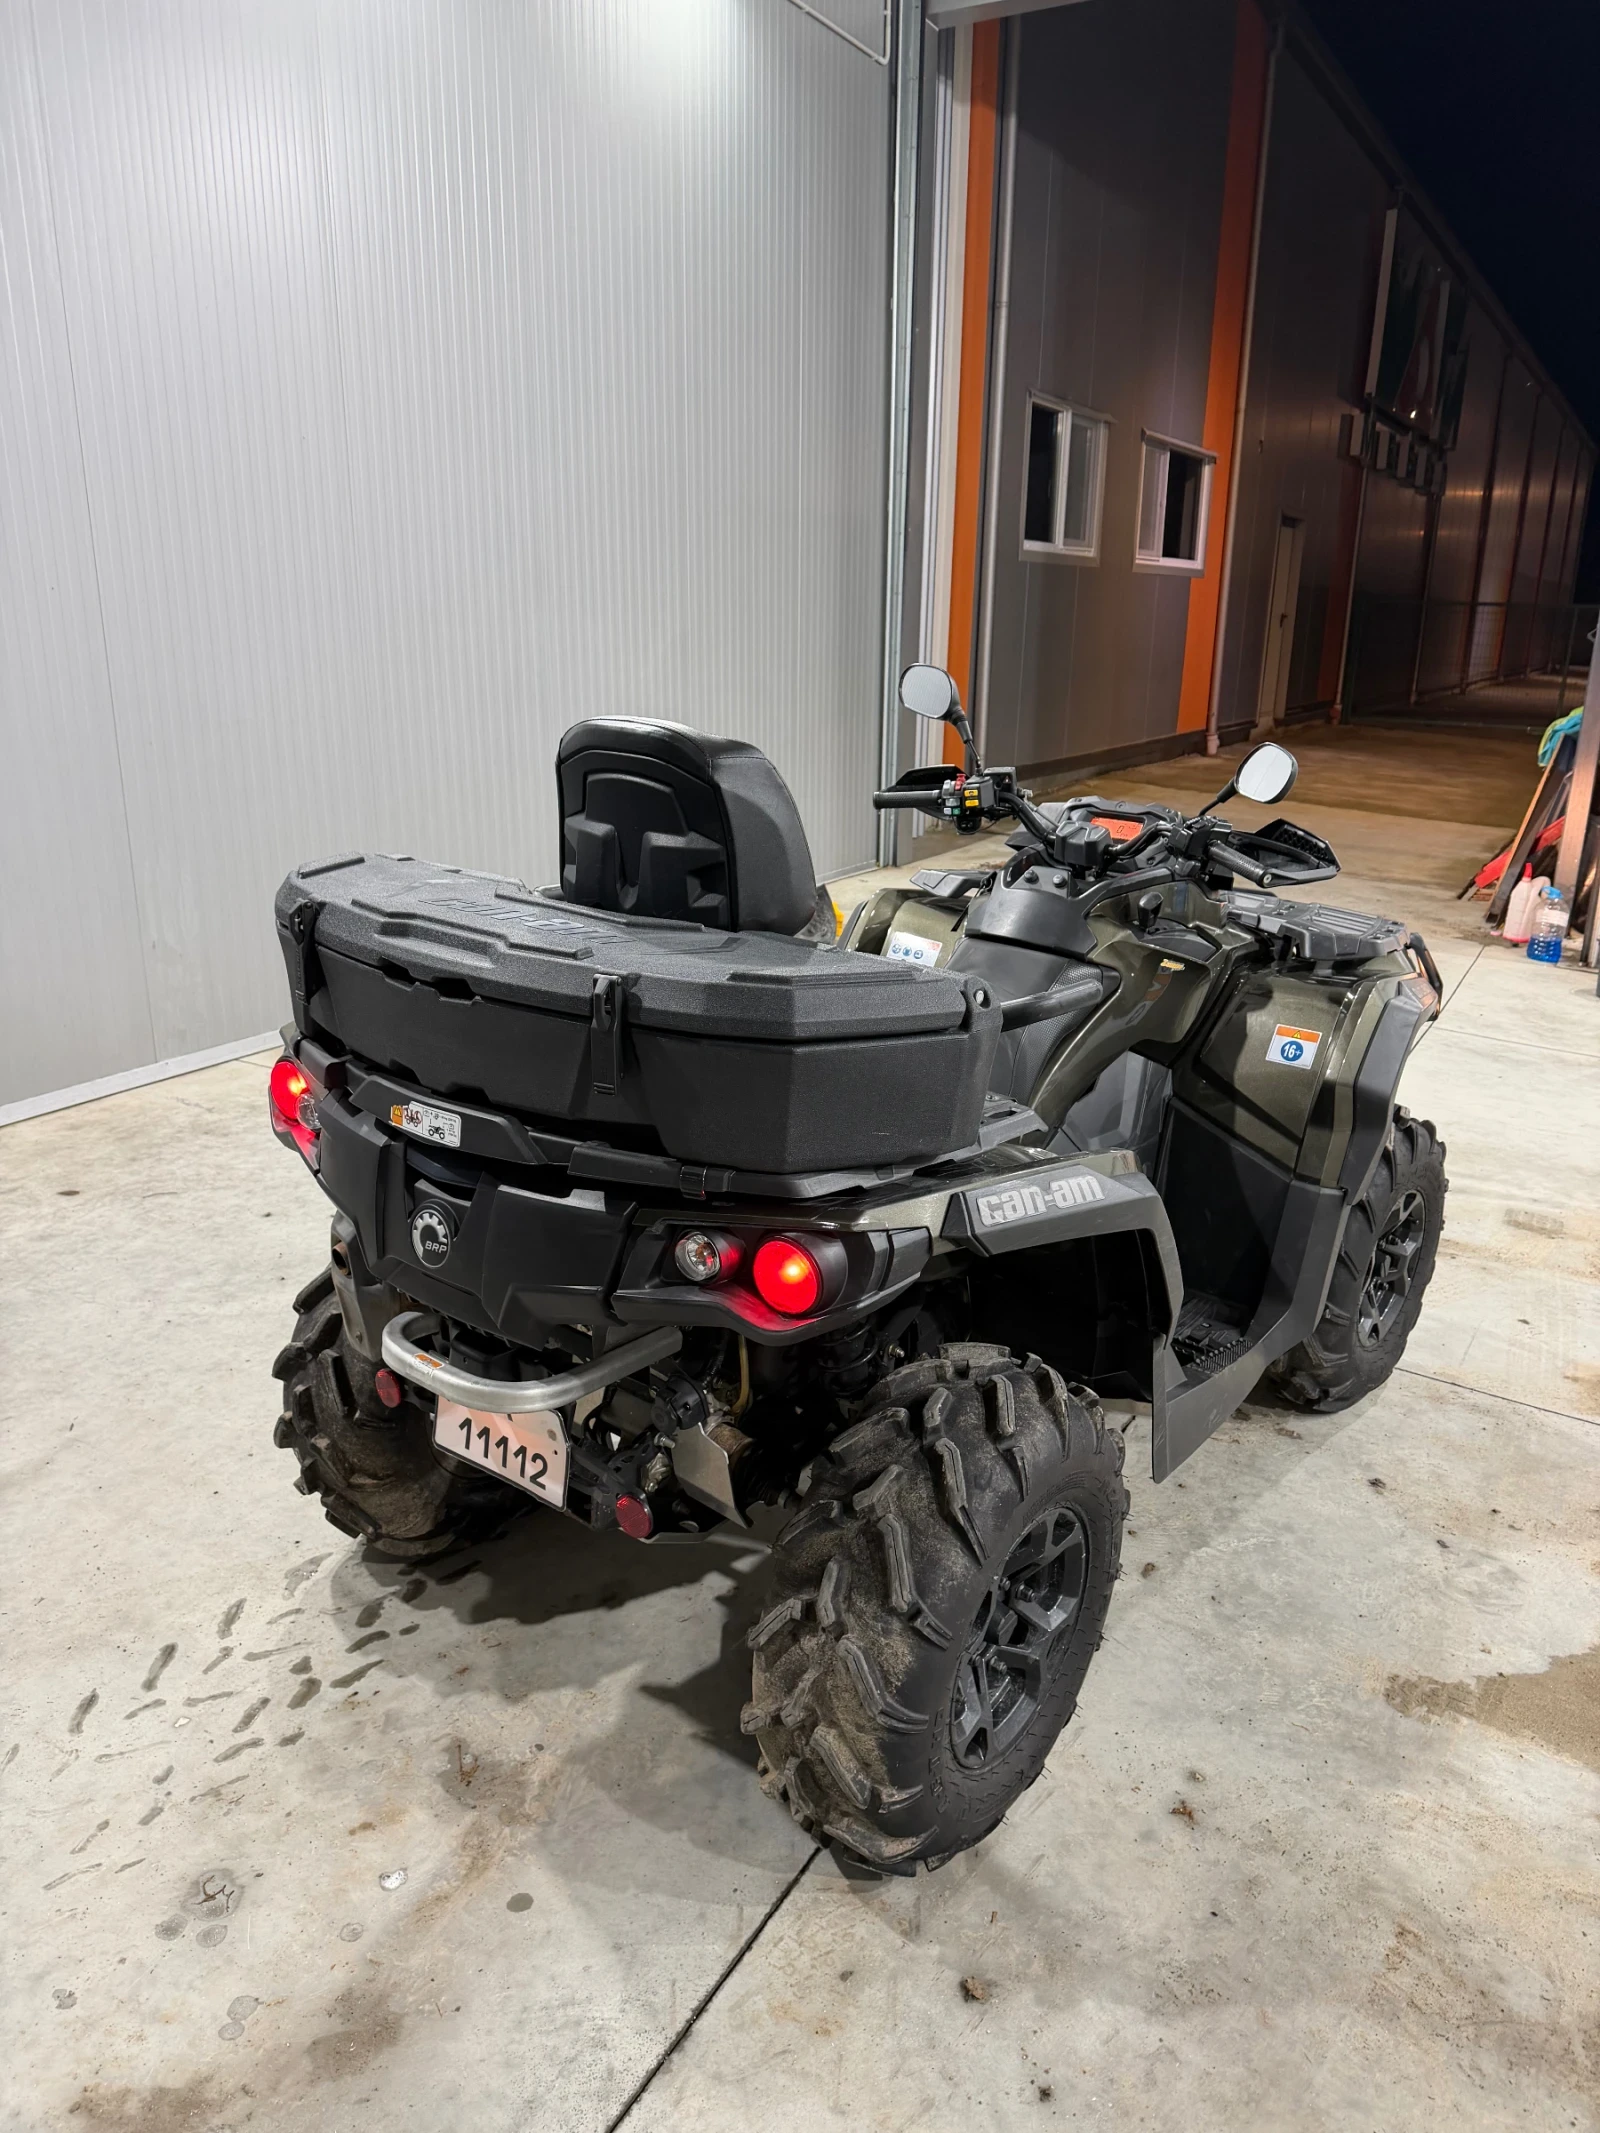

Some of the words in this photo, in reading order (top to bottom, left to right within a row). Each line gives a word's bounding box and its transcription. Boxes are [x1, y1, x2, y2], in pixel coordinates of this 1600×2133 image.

[976, 1175, 1105, 1227] can-am
[425, 1240, 447, 1254] BRP
[458, 1417, 546, 1490] 11112
